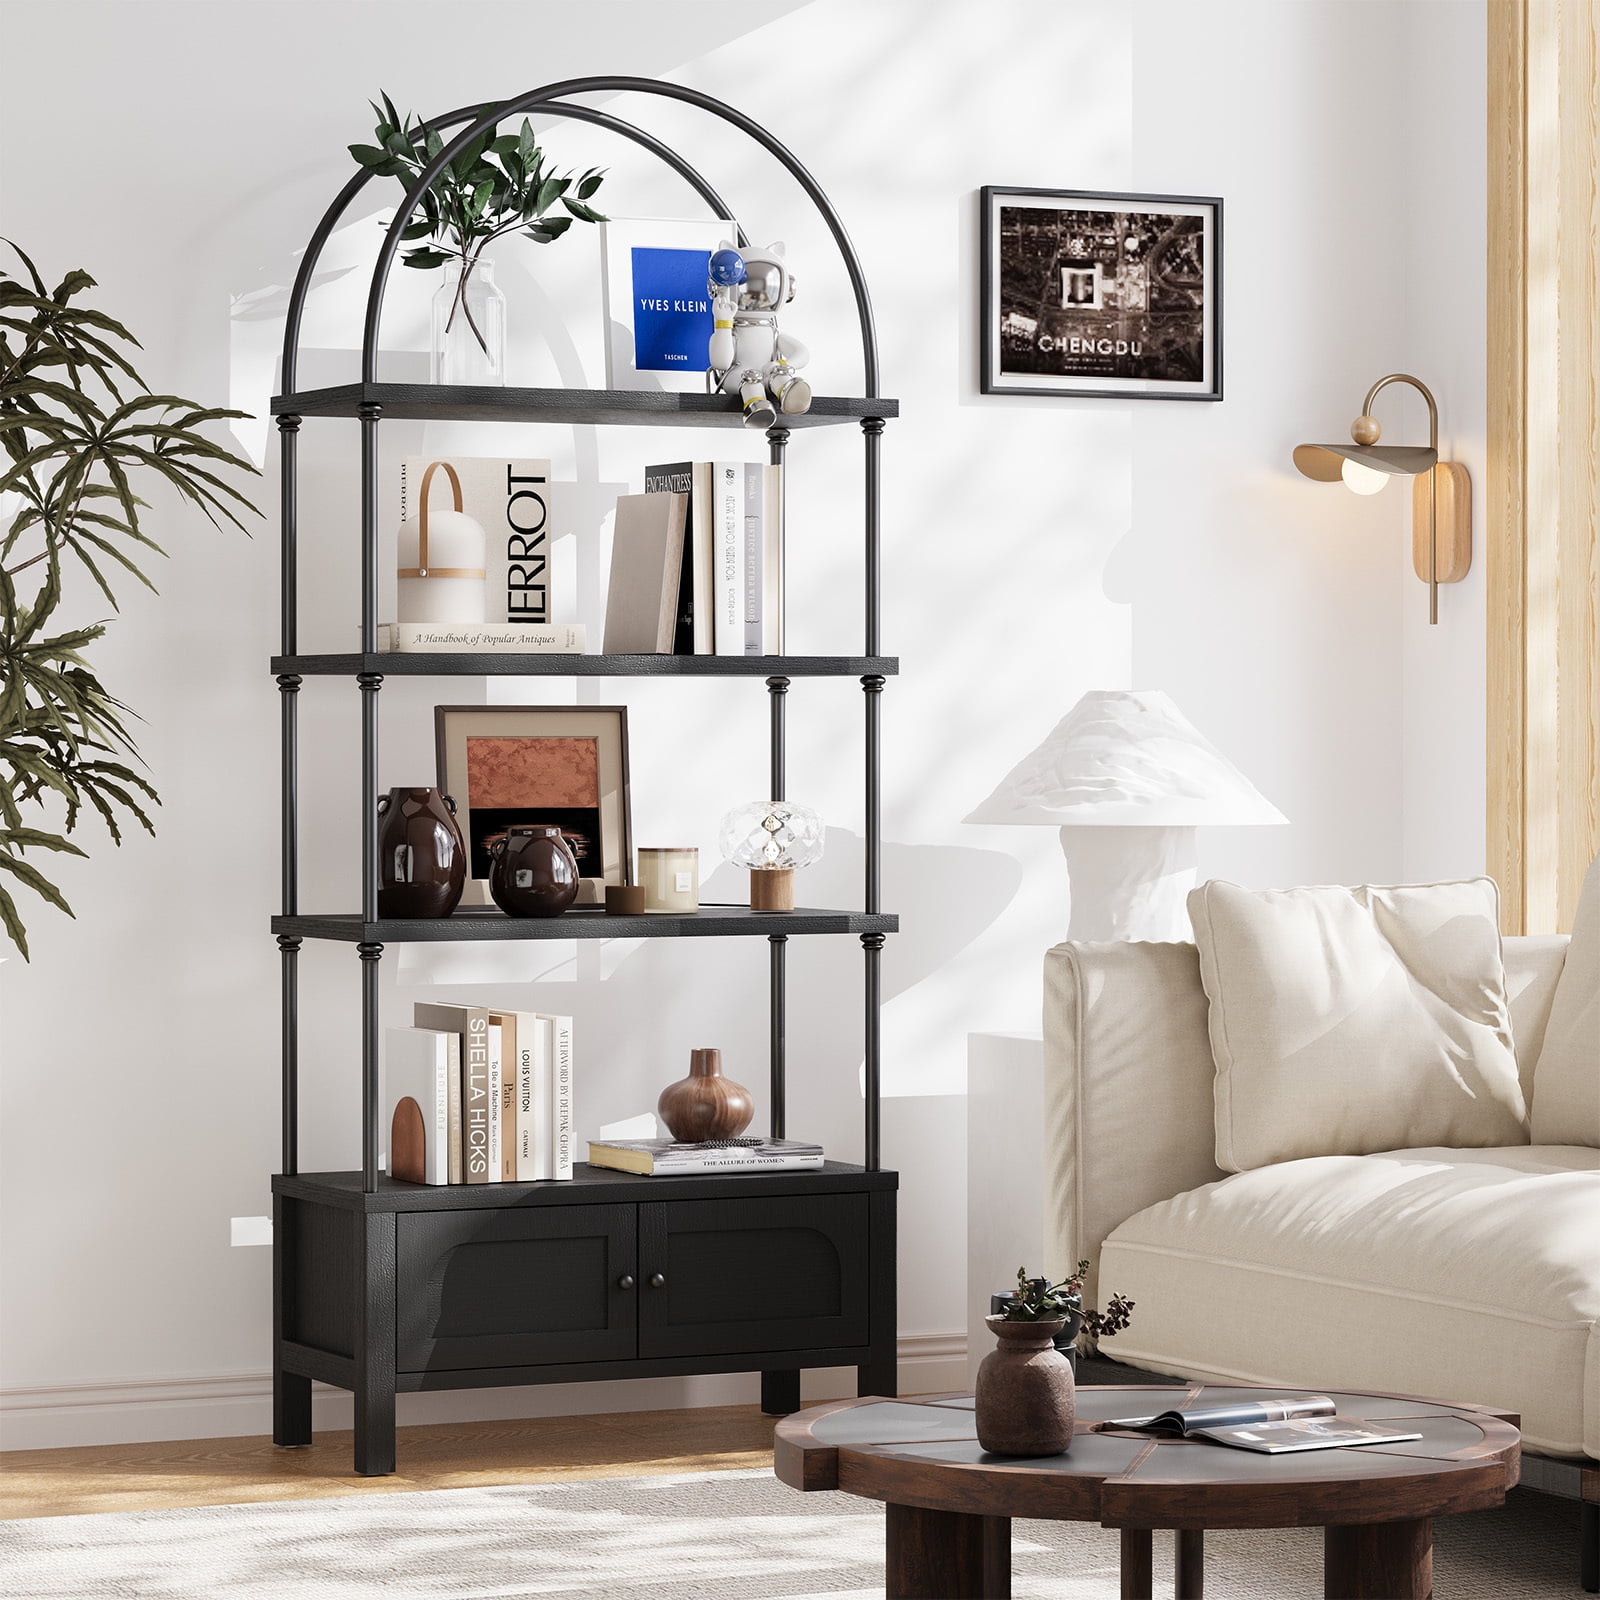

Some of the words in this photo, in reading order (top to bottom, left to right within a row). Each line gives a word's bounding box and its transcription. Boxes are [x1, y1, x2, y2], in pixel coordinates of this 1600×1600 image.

[640, 298, 670, 312] YVES
[674, 299, 707, 313] KLEIN
[664, 353, 688, 361] TASCHEN
[1038, 334, 1142, 356] CHENGDU
[647, 472, 692, 494] ENCHANTRESS
[507, 463, 547, 623] IERROT
[413, 633, 422, 644] A
[424, 633, 470, 645] Handbook
[470, 632, 482, 647] of
[482, 634, 516, 647] Popular
[516, 634, 556, 647] Antiques
[491, 1061, 499, 1070] To
[521, 1049, 530, 1075] LOUIS
[559, 1028, 569, 1082] AFTERWORD
[491, 1071, 499, 1082] Be
[503, 1083, 514, 1109] Paris
[521, 1076, 530, 1112] VUITTON
[559, 1085, 569, 1097] BY
[491, 1089, 499, 1121] Machine
[559, 1099, 569, 1132] DEEPAK
[470, 1108, 486, 1174] HICKS
[559, 1133, 569, 1170] CHOPRA
[757, 1157, 786, 1165] WOMEN
